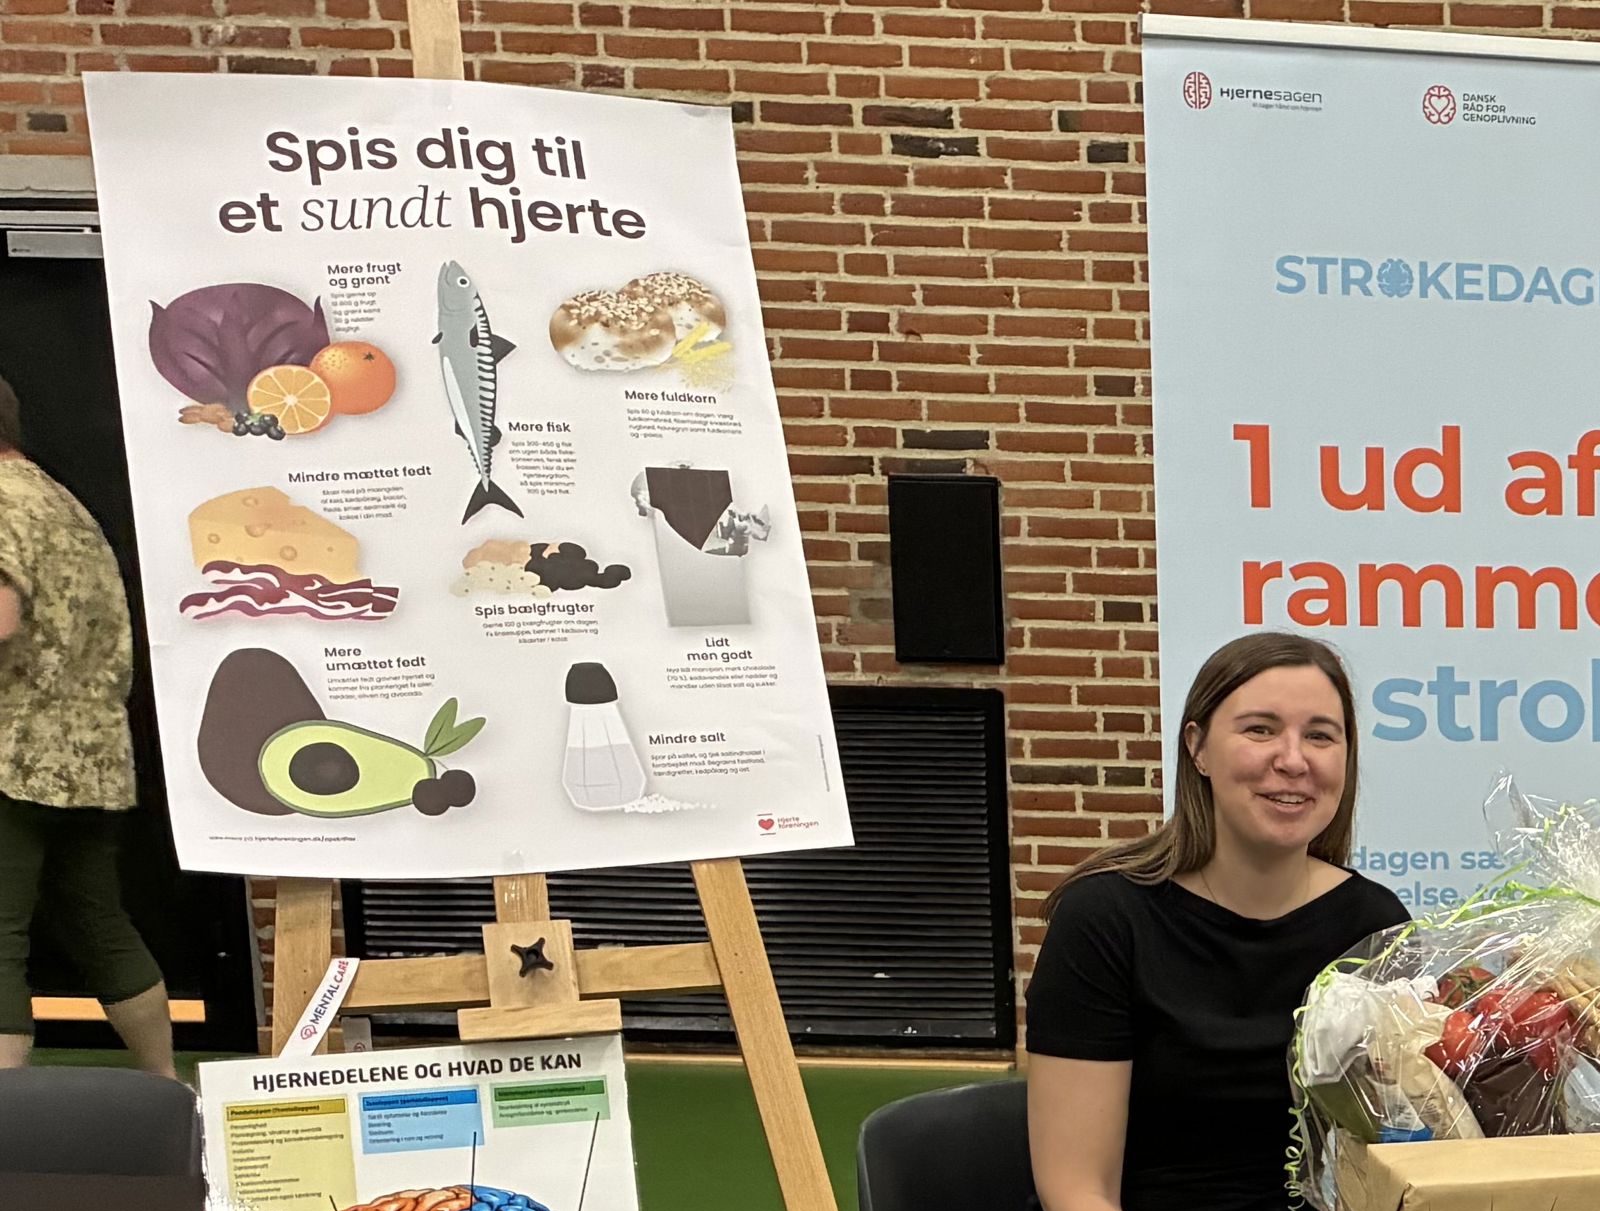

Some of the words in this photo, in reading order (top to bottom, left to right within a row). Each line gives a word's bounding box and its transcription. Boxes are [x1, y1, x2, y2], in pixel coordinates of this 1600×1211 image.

[1463, 93, 1496, 103] DANSK
[1463, 102, 1483, 112] RÅD
[1486, 105, 1506, 113] FOR
[1462, 113, 1536, 125] GENOPLIVNING
[265, 126, 398, 186] Spis
[416, 126, 516, 185] dig
[532, 136, 587, 180] til
[218, 193, 283, 233] et
[301, 184, 453, 232] sundt
[469, 187, 647, 243] hjerte
[327, 265, 363, 275] Mere
[367, 262, 402, 275] frugt
[329, 278, 347, 289] og
[351, 275, 391, 288] grønt
[625, 390, 659, 401] Mere
[661, 391, 717, 404] fuldkorn
[508, 422, 543, 431] Mere
[547, 422, 571, 432] fisk
[288, 472, 340, 483] Mindre
[343, 467, 399, 481] mættet
[403, 465, 432, 477] fedt
[1233, 423, 1272, 509] 1
[1319, 424, 1462, 514] ud
[475, 605, 505, 619] Spis
[508, 602, 595, 616] bælgfrugter
[705, 637, 730, 647] Lidt
[324, 647, 362, 657] Mere
[687, 652, 718, 661] men
[721, 650, 753, 663] godt
[326, 659, 393, 671] umættet
[396, 656, 426, 668] fedt
[649, 734, 697, 745] Mindre
[700, 732, 726, 743] salt
[1351, 846, 1449, 876] dagen
[252, 1064, 409, 1093] HJERNEDELENE
[414, 1062, 442, 1080] OG
[448, 1057, 504, 1077] HVAD
[509, 1055, 534, 1072] DE
[541, 1053, 582, 1071] KAN
